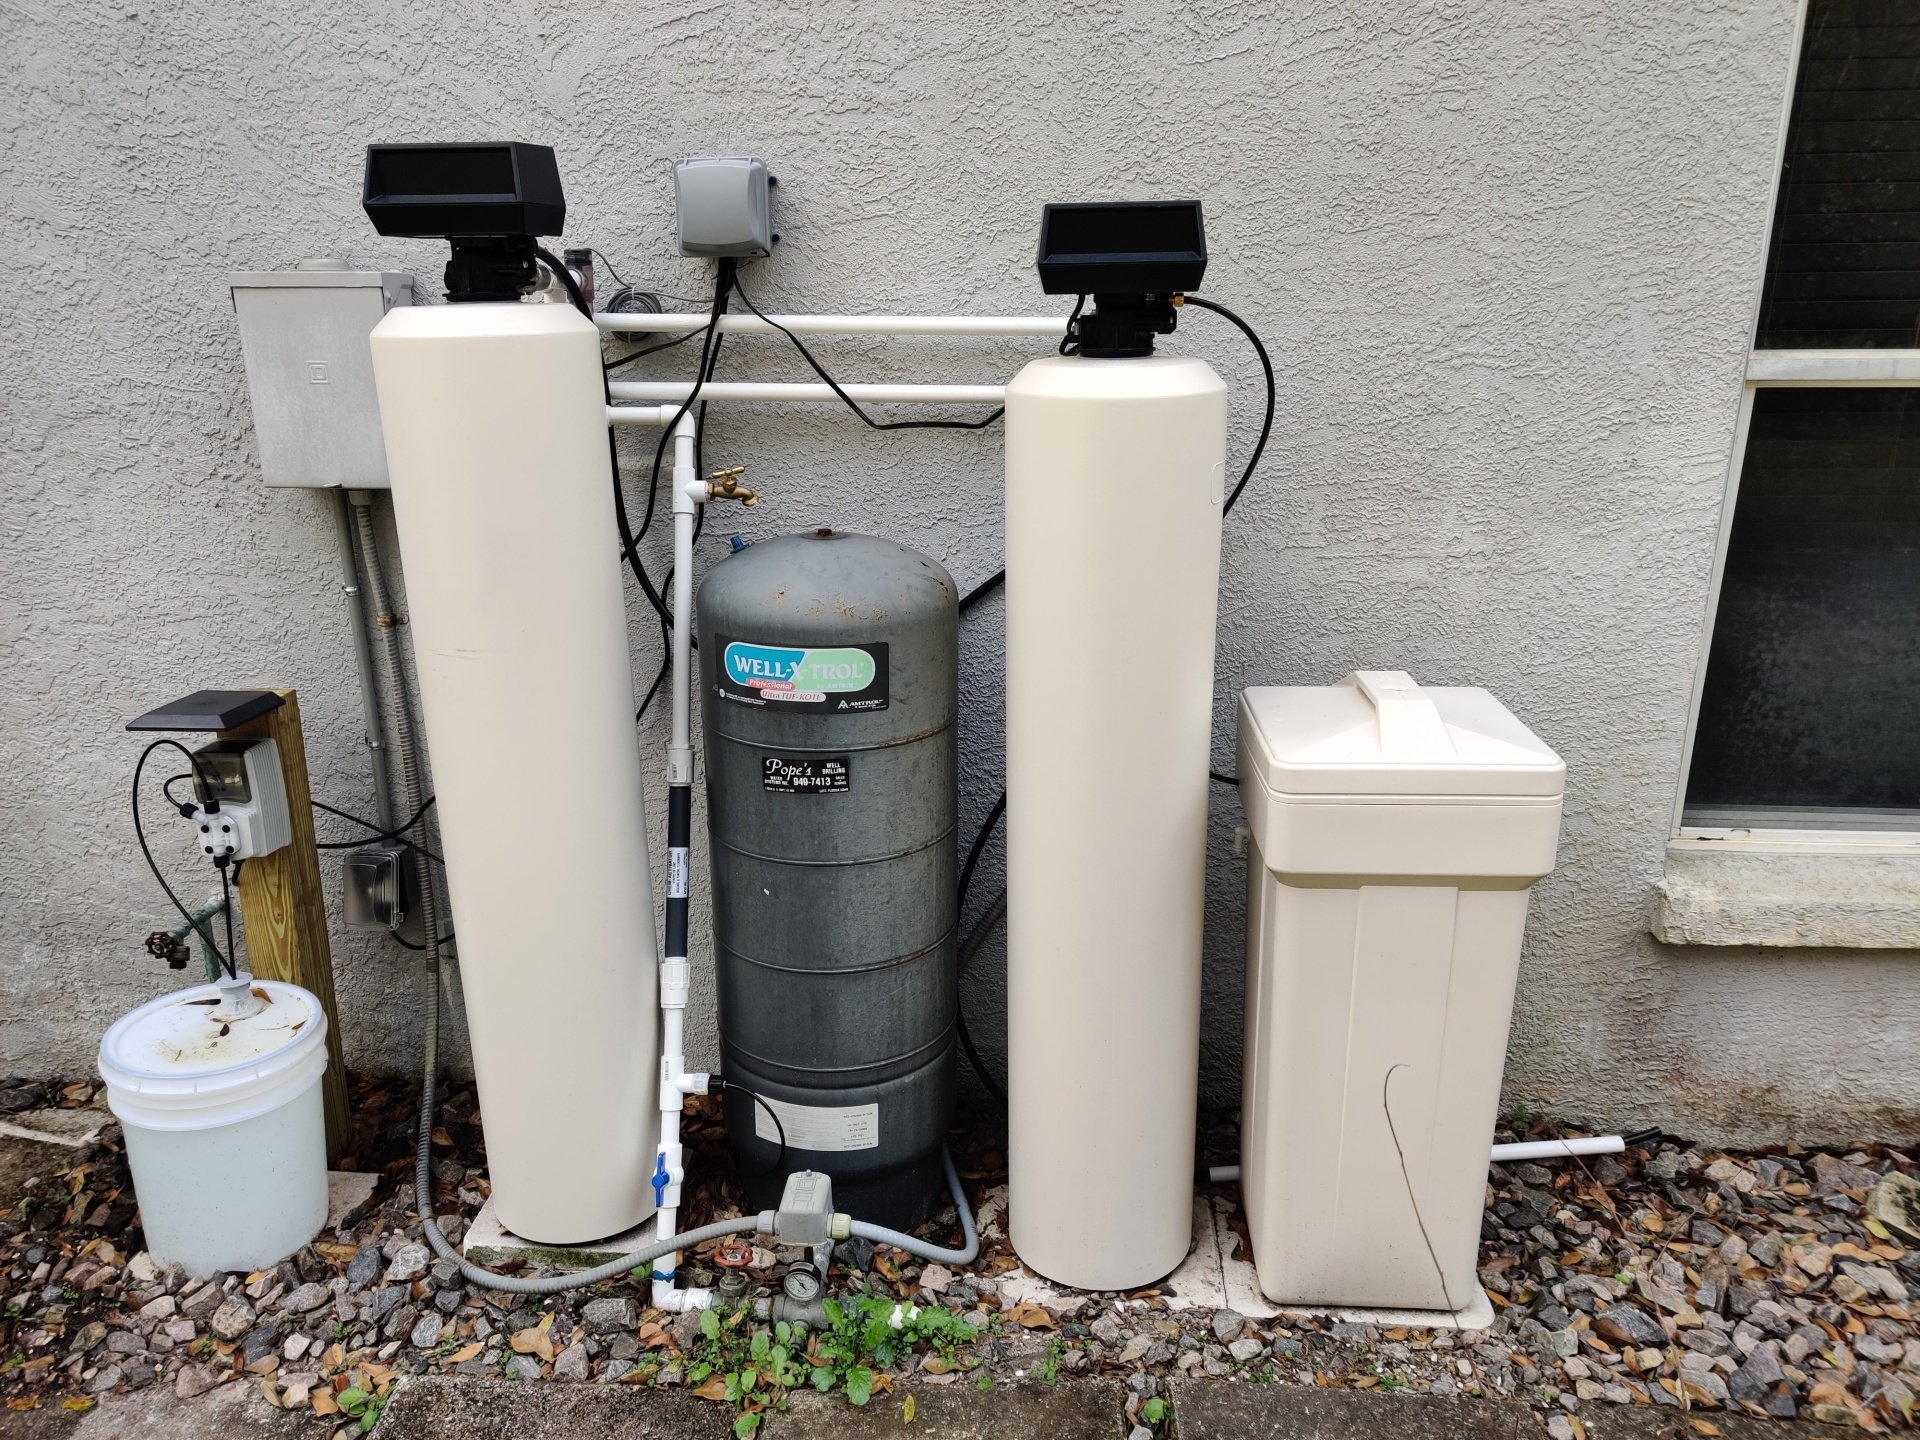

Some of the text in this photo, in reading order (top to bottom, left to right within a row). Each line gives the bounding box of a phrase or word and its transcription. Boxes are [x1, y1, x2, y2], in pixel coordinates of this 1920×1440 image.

[749, 679, 793, 690] Professional
[766, 759, 812, 781] Pope's
[794, 777, 830, 786] 949-7413
